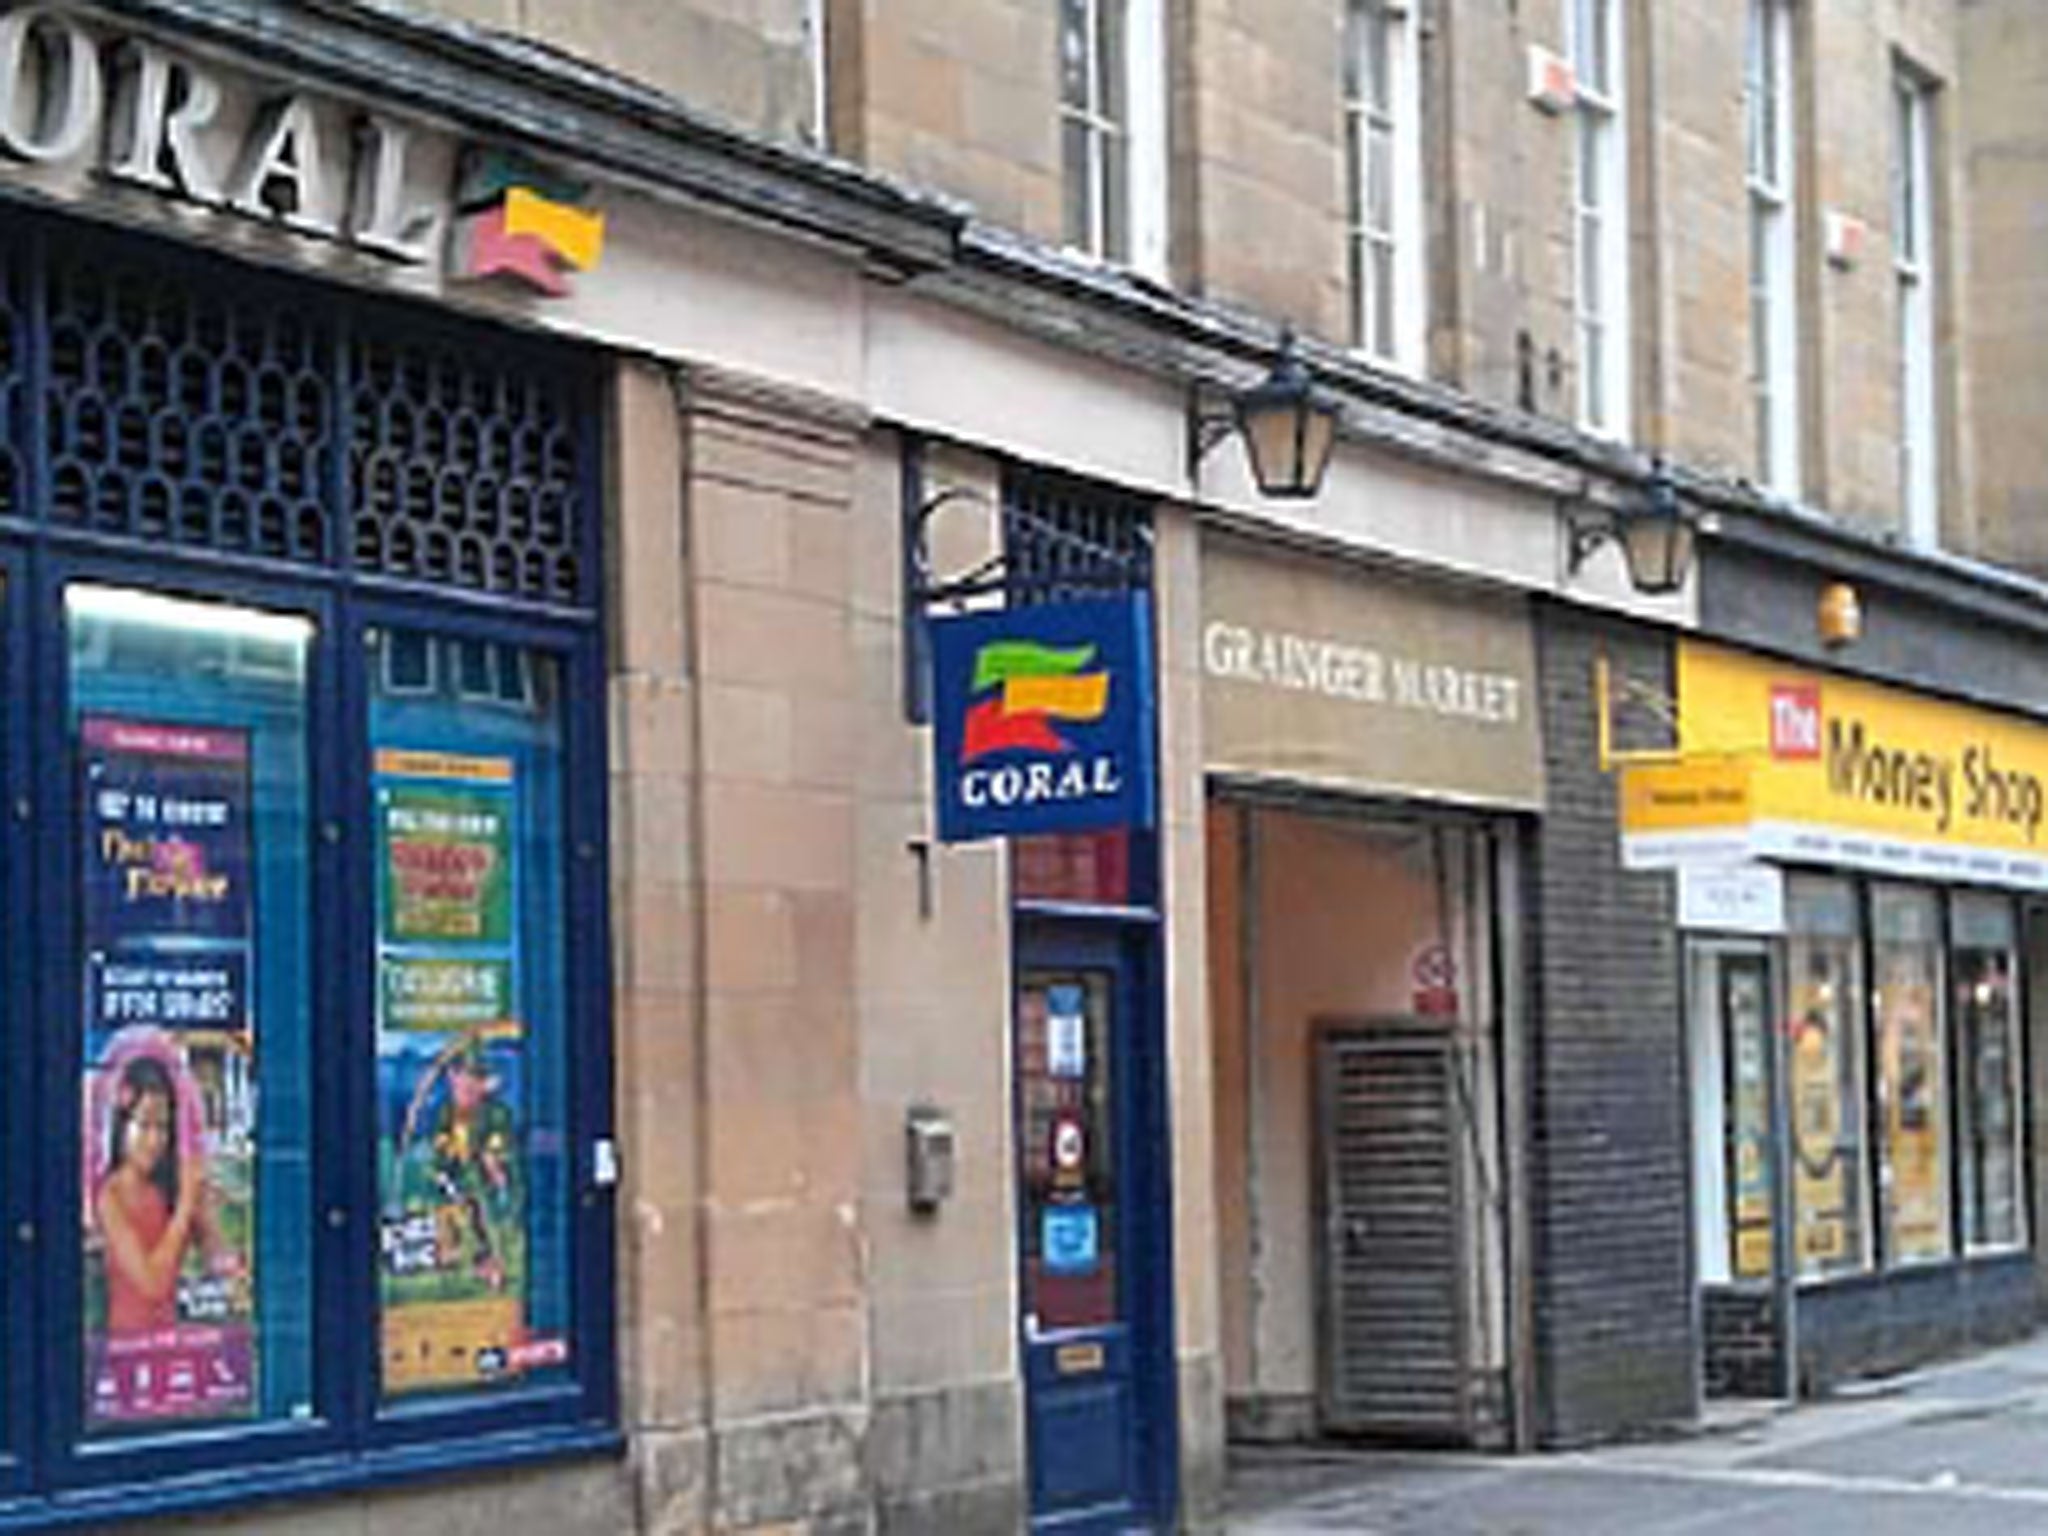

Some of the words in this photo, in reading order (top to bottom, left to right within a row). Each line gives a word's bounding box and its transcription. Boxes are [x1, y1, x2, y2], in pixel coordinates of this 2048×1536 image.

[1204, 620, 1386, 704] GRAINGER
[1394, 660, 1520, 724] MARKET
[960, 756, 1122, 806] CORAL
[1771, 692, 1818, 752] The
[1826, 716, 1956, 834] Money
[1962, 742, 2045, 844] Shop
